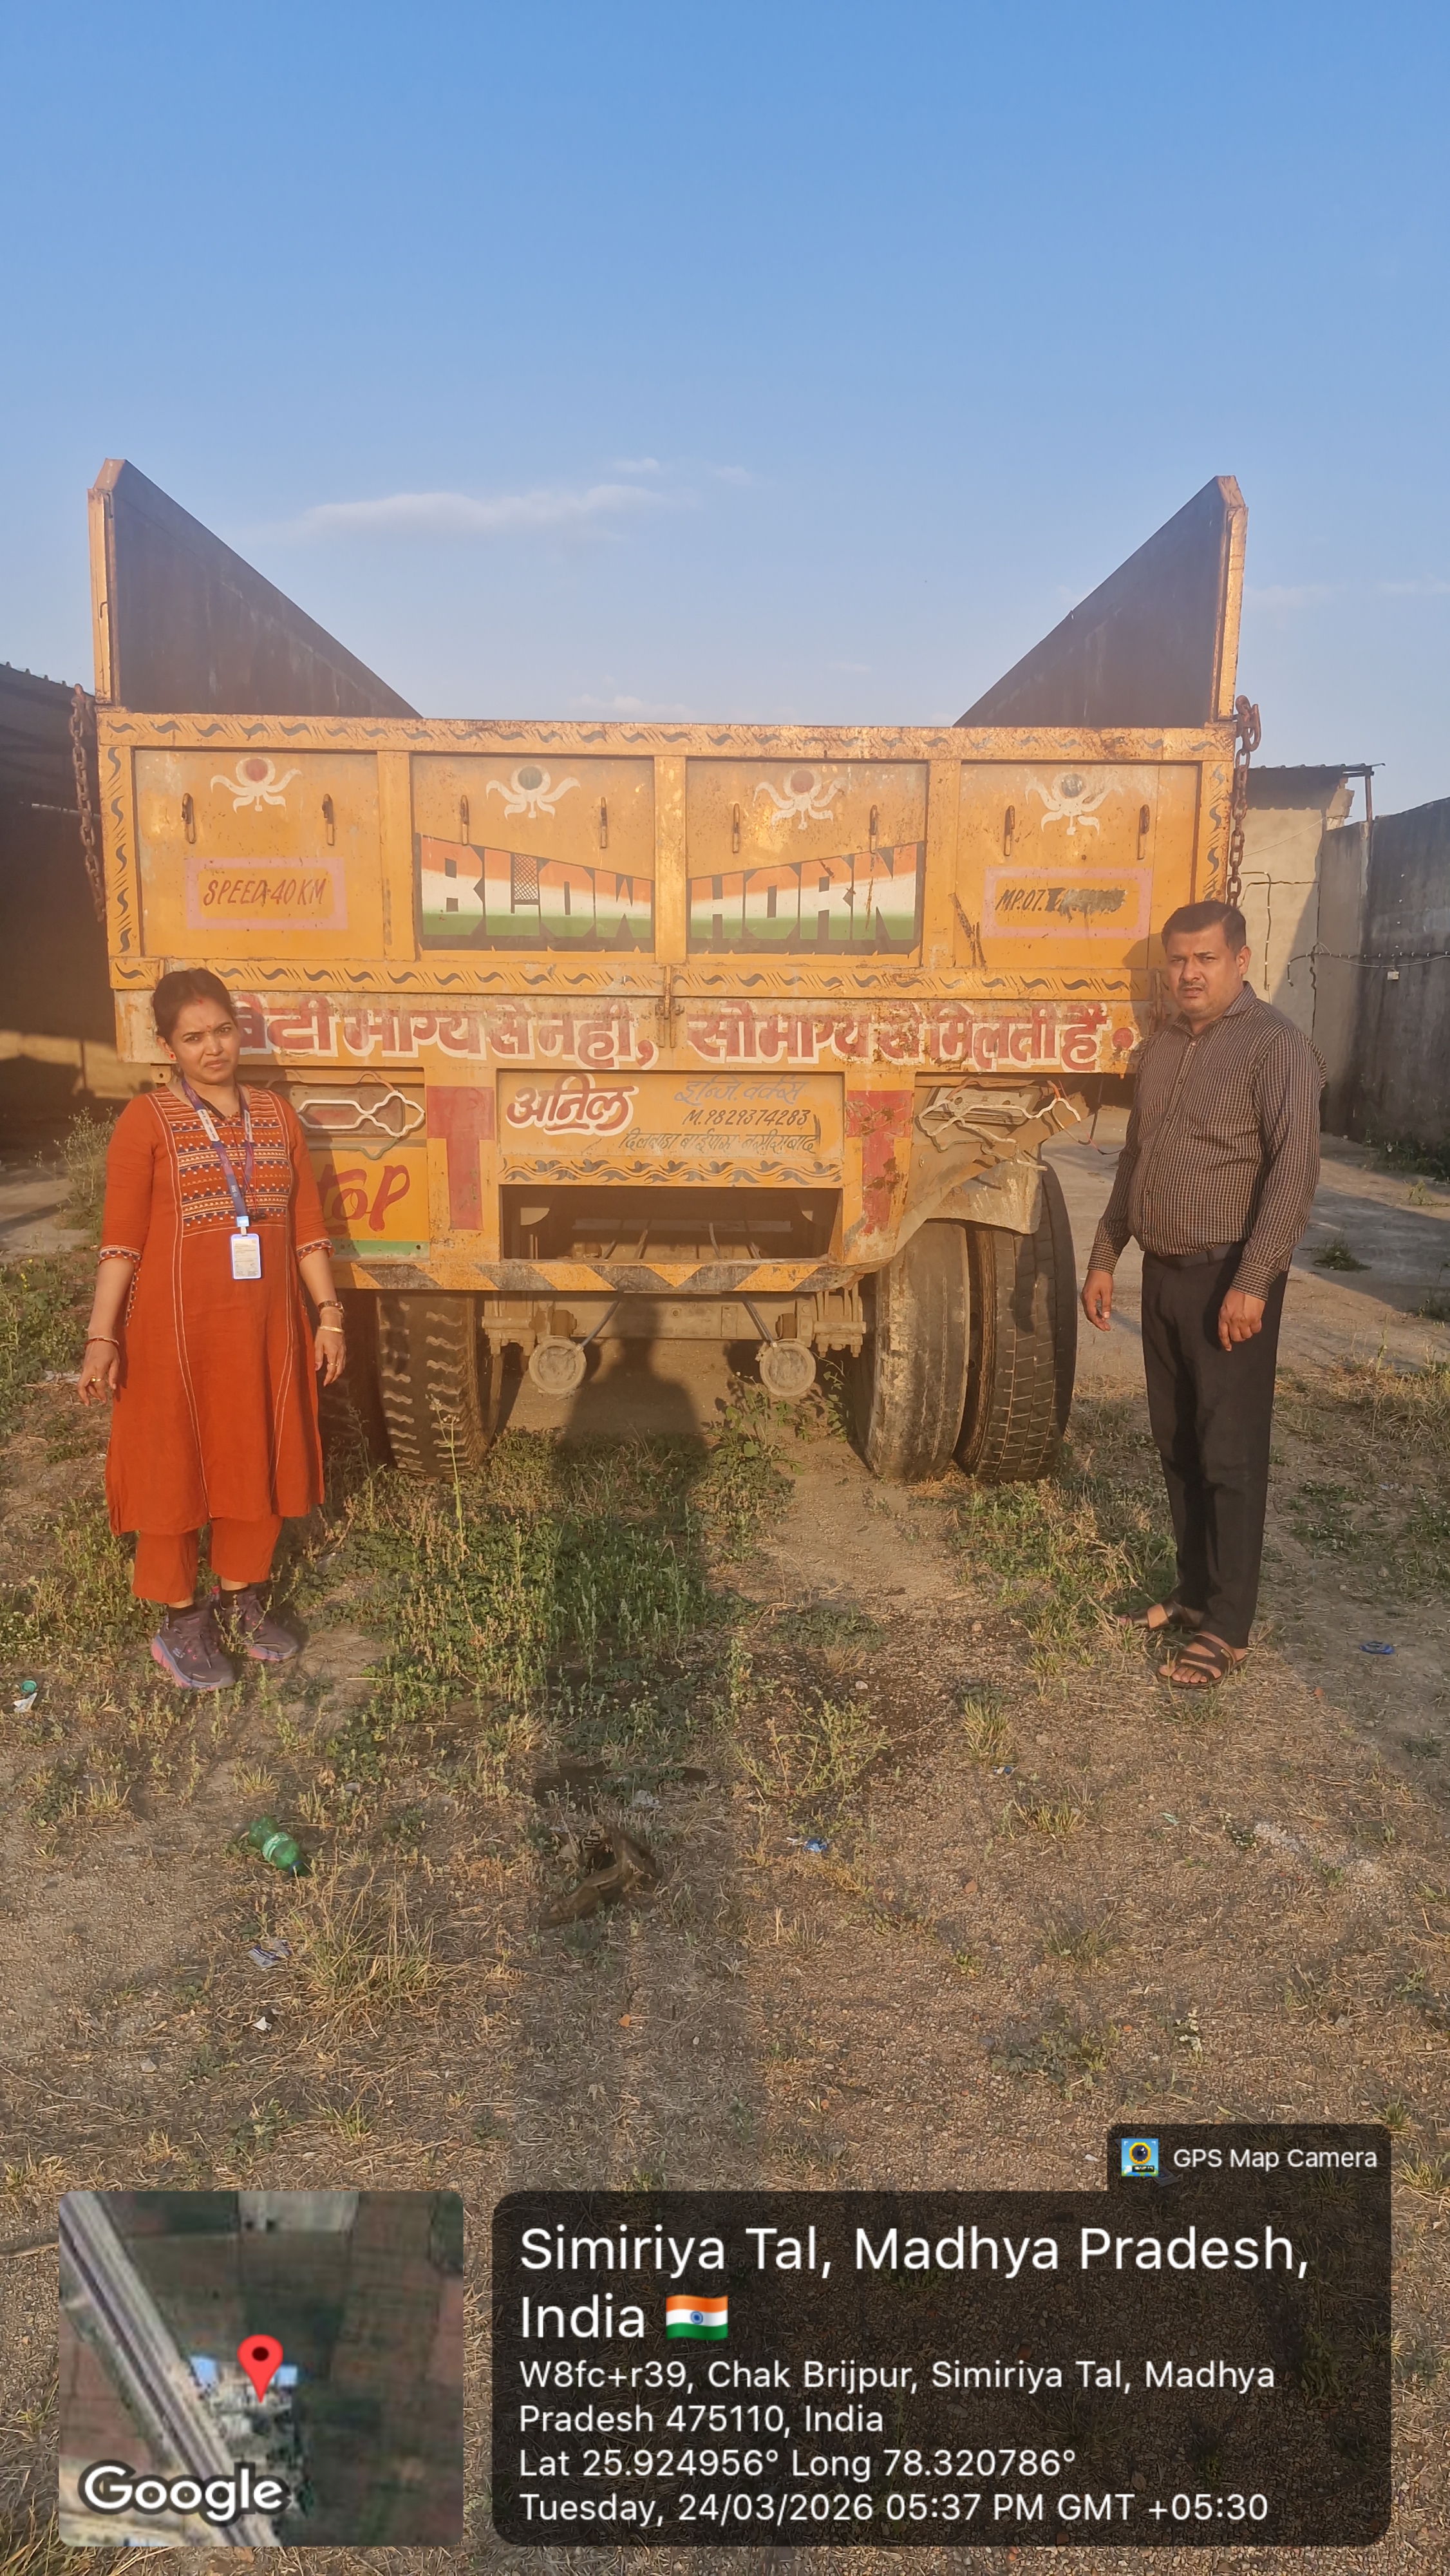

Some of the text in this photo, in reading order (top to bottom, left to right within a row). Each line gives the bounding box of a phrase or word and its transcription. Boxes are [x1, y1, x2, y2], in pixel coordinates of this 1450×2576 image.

[421, 836, 917, 940] BLOW HORN
[506, 1073, 639, 1137] अनिल
